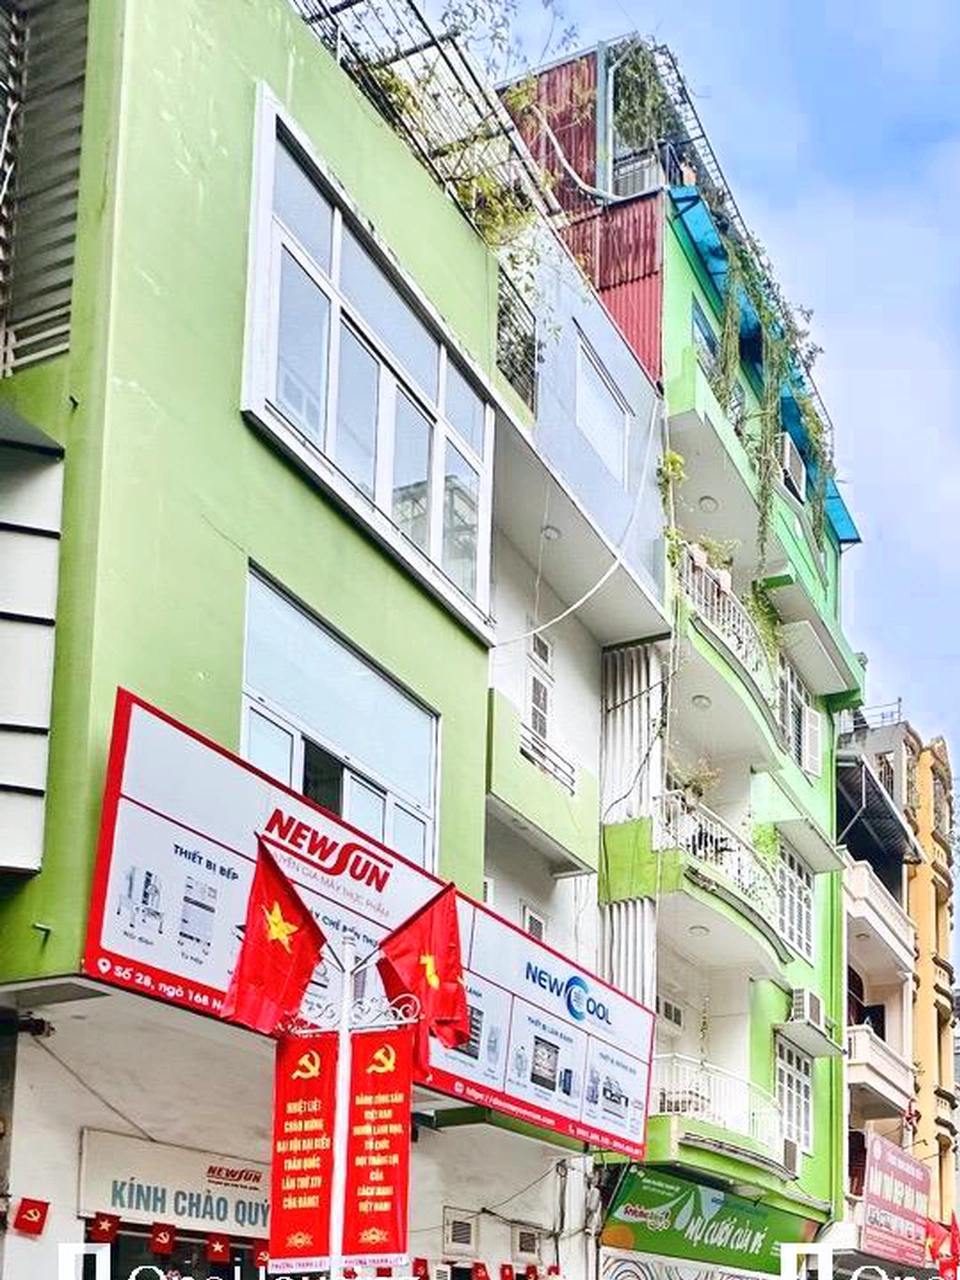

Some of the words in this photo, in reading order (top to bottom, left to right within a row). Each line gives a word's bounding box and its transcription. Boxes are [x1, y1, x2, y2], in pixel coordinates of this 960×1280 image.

[173, 843, 203, 866] THIẾT
[205, 857, 217, 876] BỊ
[219, 863, 239, 882] BẾP
[262, 807, 394, 894] NEWSUN
[113, 965, 132, 981] Số
[206, 1165, 263, 1184] NEWSUN
[111, 1177, 167, 1214] KÍNH
[173, 1189, 229, 1222] CHÀO
[234, 1198, 271, 1228] QUÝ
